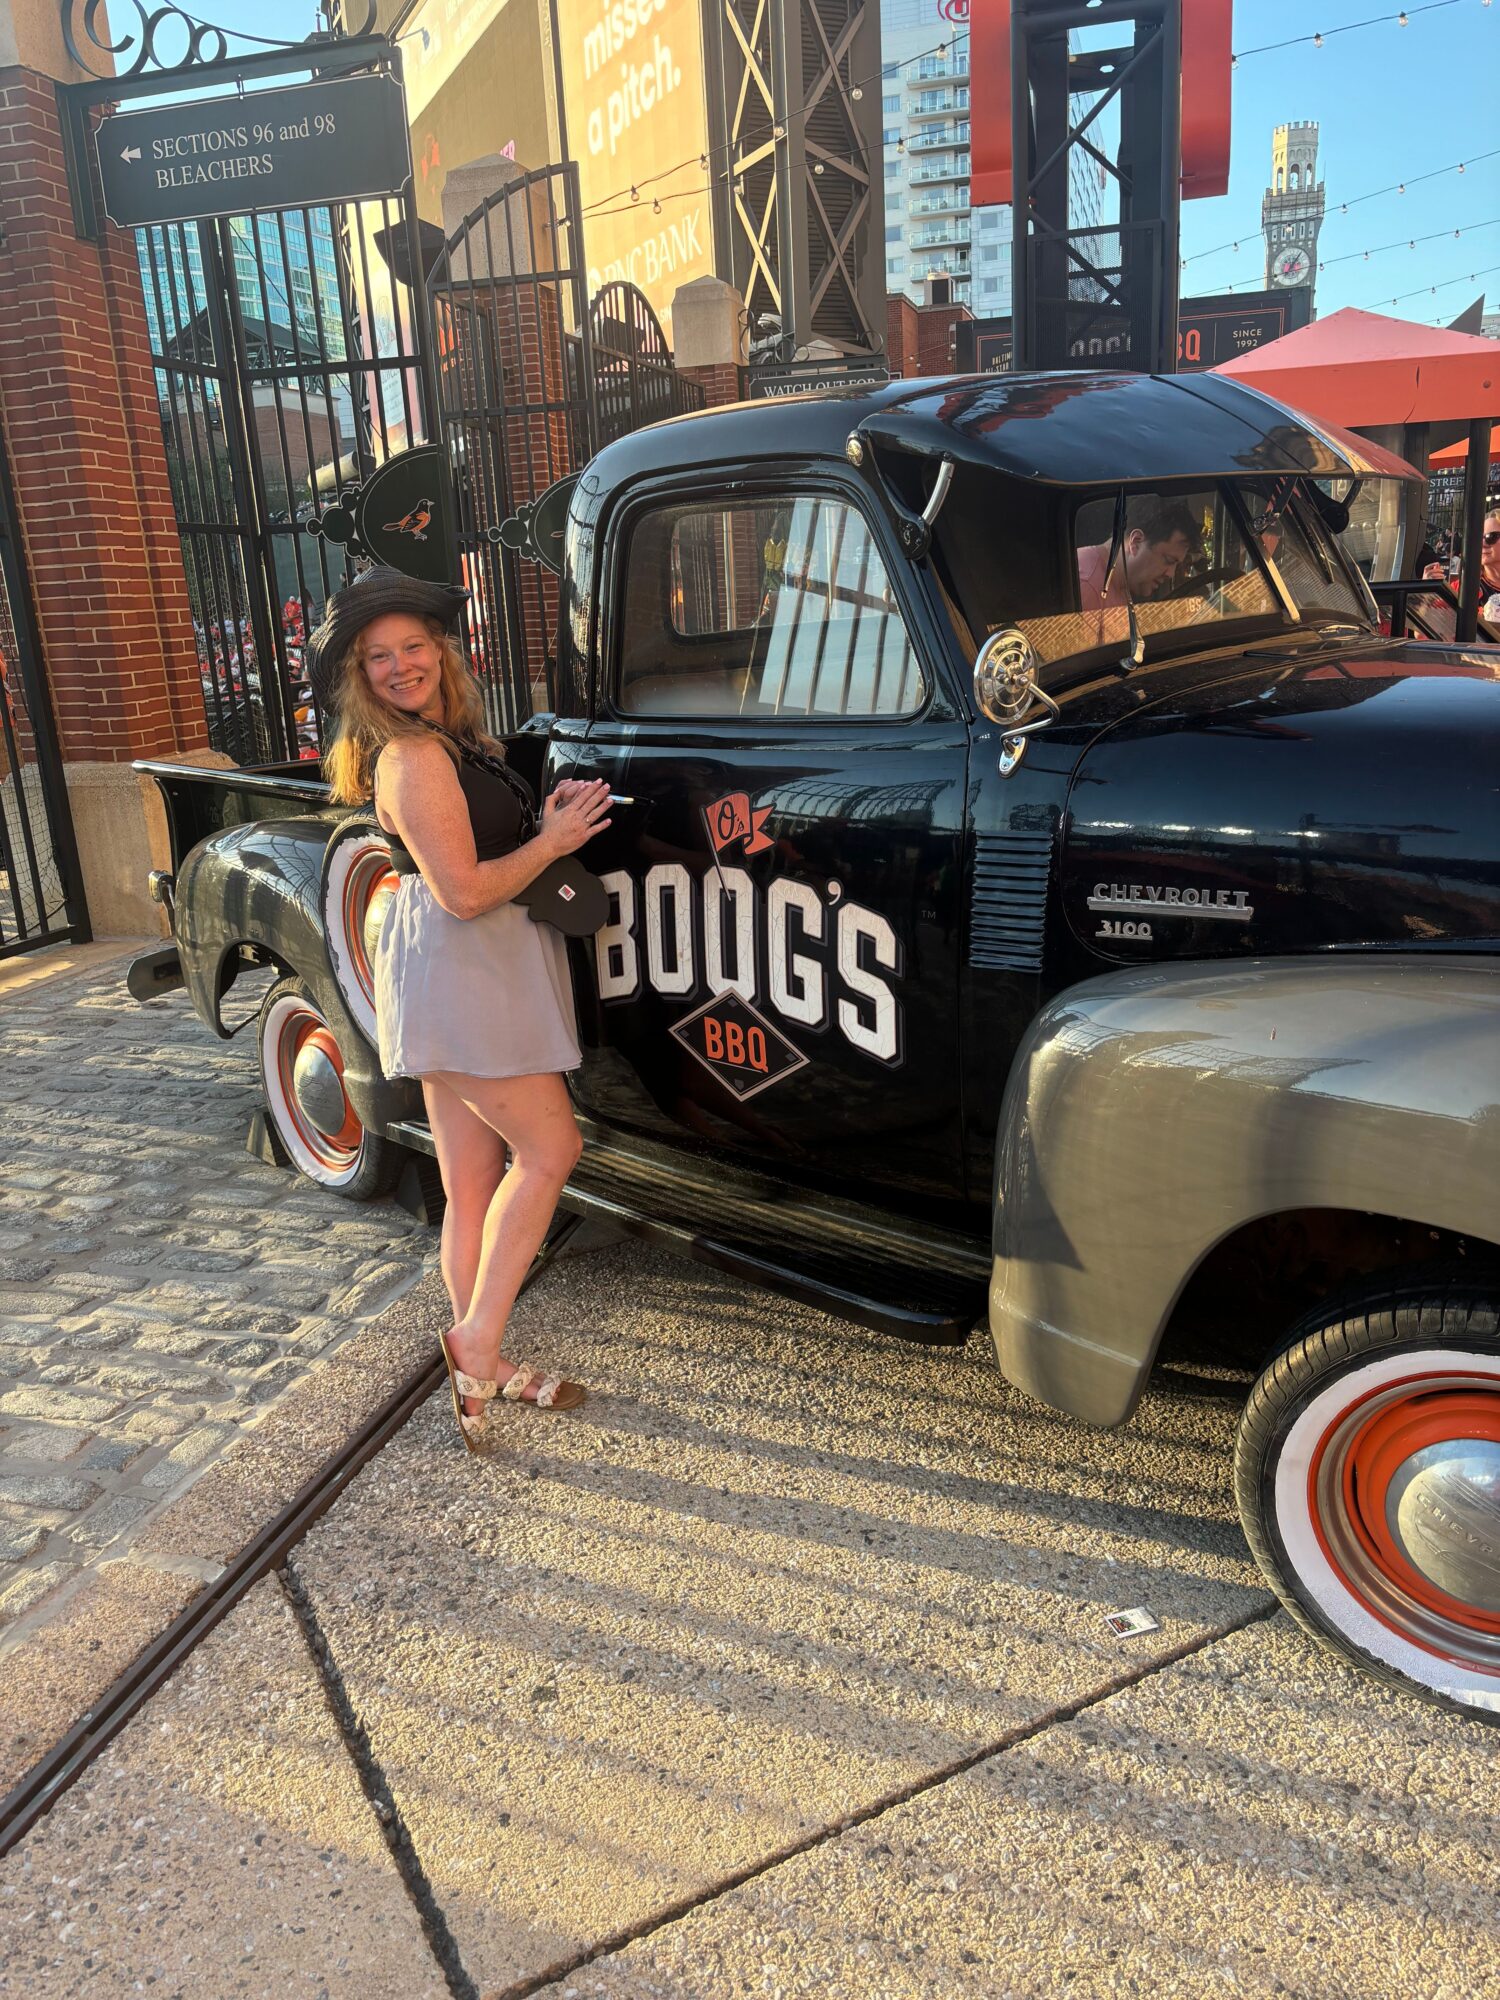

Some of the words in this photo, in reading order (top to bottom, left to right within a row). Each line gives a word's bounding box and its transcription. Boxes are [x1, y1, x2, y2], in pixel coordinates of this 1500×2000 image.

[583, 0, 666, 80] misse
[588, 107, 603, 156] a
[608, 33, 681, 157] pitch.
[152, 126, 249, 160] SECTIONS
[252, 122, 275, 145] 96
[279, 117, 310, 141] and
[314, 113, 336, 136] 98
[156, 153, 274, 189] BLEACHERS
[643, 208, 703, 285] BANK
[1232, 328, 1262, 338] SINCE
[1236, 339, 1258, 348] 1992
[764, 383, 811, 398] WATCH
[718, 800, 744, 840] O's
[921, 910, 936, 920] TM
[1093, 883, 1250, 909] CHEVROLET
[1101, 920, 1151, 936] 3100
[595, 862, 900, 1066] BOOG'S
[704, 1016, 768, 1073] BBQ
